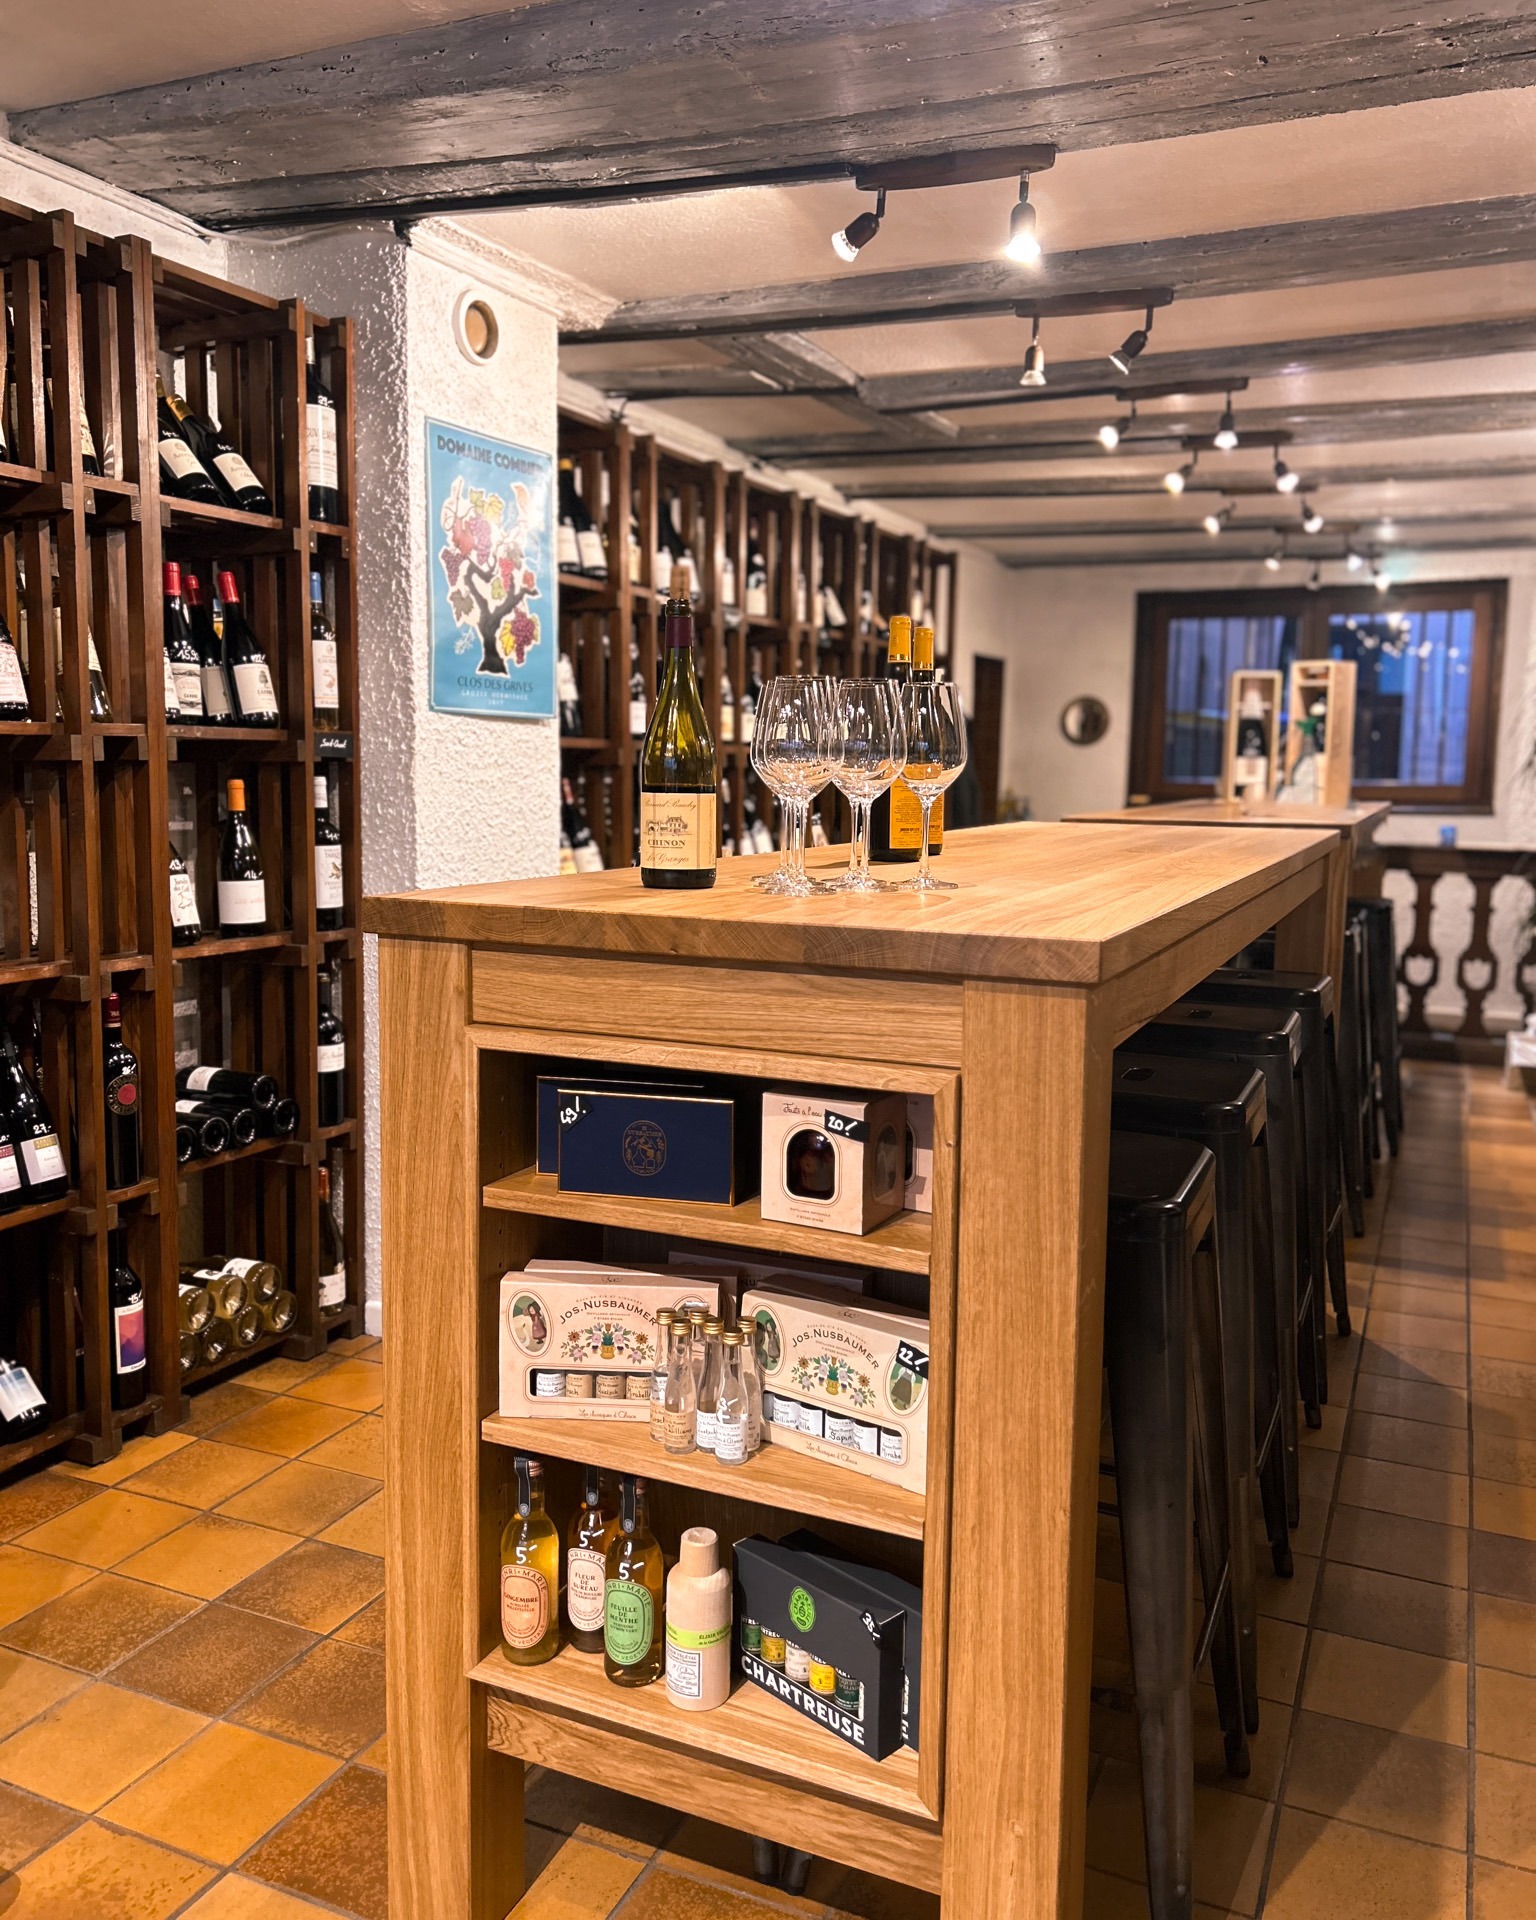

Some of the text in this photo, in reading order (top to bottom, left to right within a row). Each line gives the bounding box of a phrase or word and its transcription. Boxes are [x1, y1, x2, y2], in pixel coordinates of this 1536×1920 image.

[437, 434, 492, 464] DOMAINE
[457, 675, 533, 692] CLOS DES GRIVES
[647, 839, 686, 847] CHINON
[522, 1570, 547, 1592] MARIE
[574, 1572, 596, 1581] FLEUR
[573, 1582, 598, 1592] SUREAU
[503, 1591, 539, 1603] GINGEMBRE
[627, 1584, 651, 1608] MARIE
[610, 1602, 637, 1613] FEUILLE
[610, 1613, 638, 1624] MENTHE
[741, 1655, 865, 1745] CHARTREUSE
